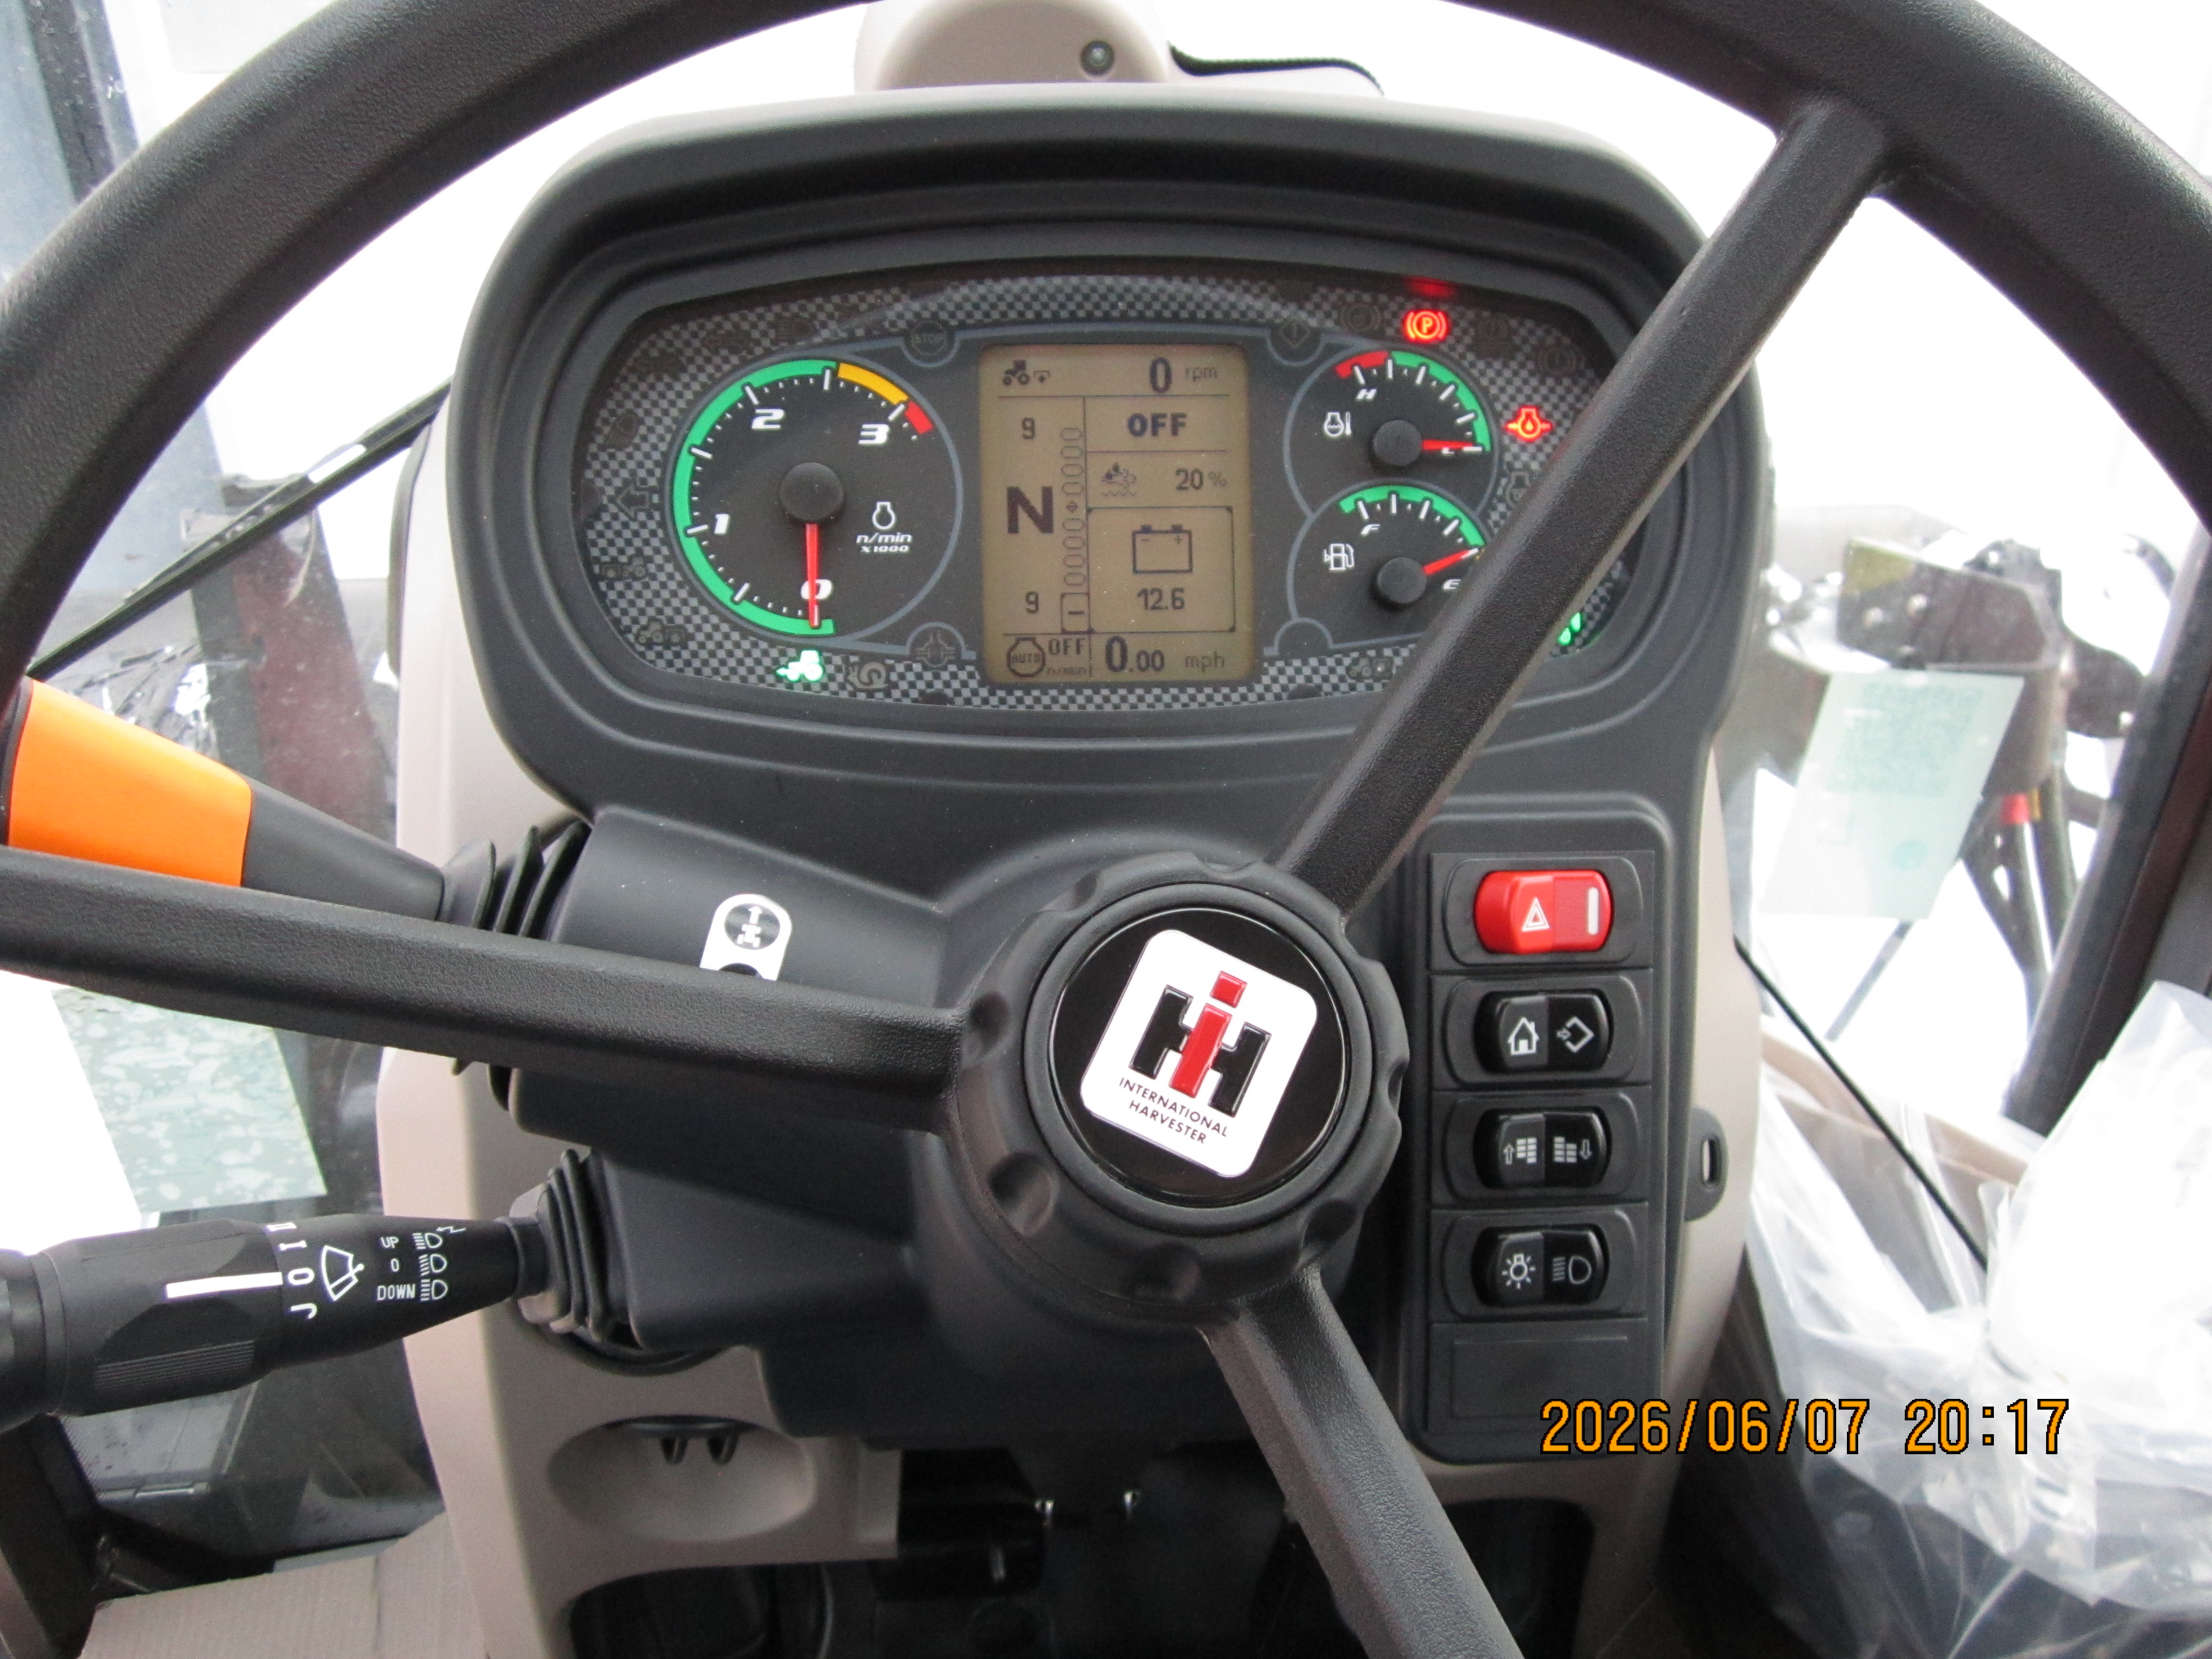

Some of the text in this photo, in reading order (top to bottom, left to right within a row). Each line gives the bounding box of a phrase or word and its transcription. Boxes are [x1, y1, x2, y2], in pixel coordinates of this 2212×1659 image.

[1150, 358, 1217, 393] 0 rpm
[1356, 389, 1377, 399] H
[751, 409, 784, 430] 2
[1022, 418, 1035, 439] 9
[1128, 413, 1187, 437] OFF
[858, 423, 890, 445] 3
[1176, 469, 1203, 490] 20
[1007, 487, 1053, 533] N
[714, 514, 729, 534] 1
[1361, 524, 1381, 535] F
[857, 533, 912, 543] n/min
[800, 579, 834, 600] 0
[1443, 579, 1461, 589] E
[1025, 591, 1039, 613] 9
[1136, 588, 1185, 610] 12.6
[1049, 638, 1085, 655] OFF
[1105, 636, 1224, 672] 0.00 mph
[1119, 1077, 1227, 1137] INTERNATIONAL
[1129, 1099, 1207, 1144] HARVESTER
[380, 1237, 399, 1248] UP
[377, 1284, 415, 1301] DOWN
